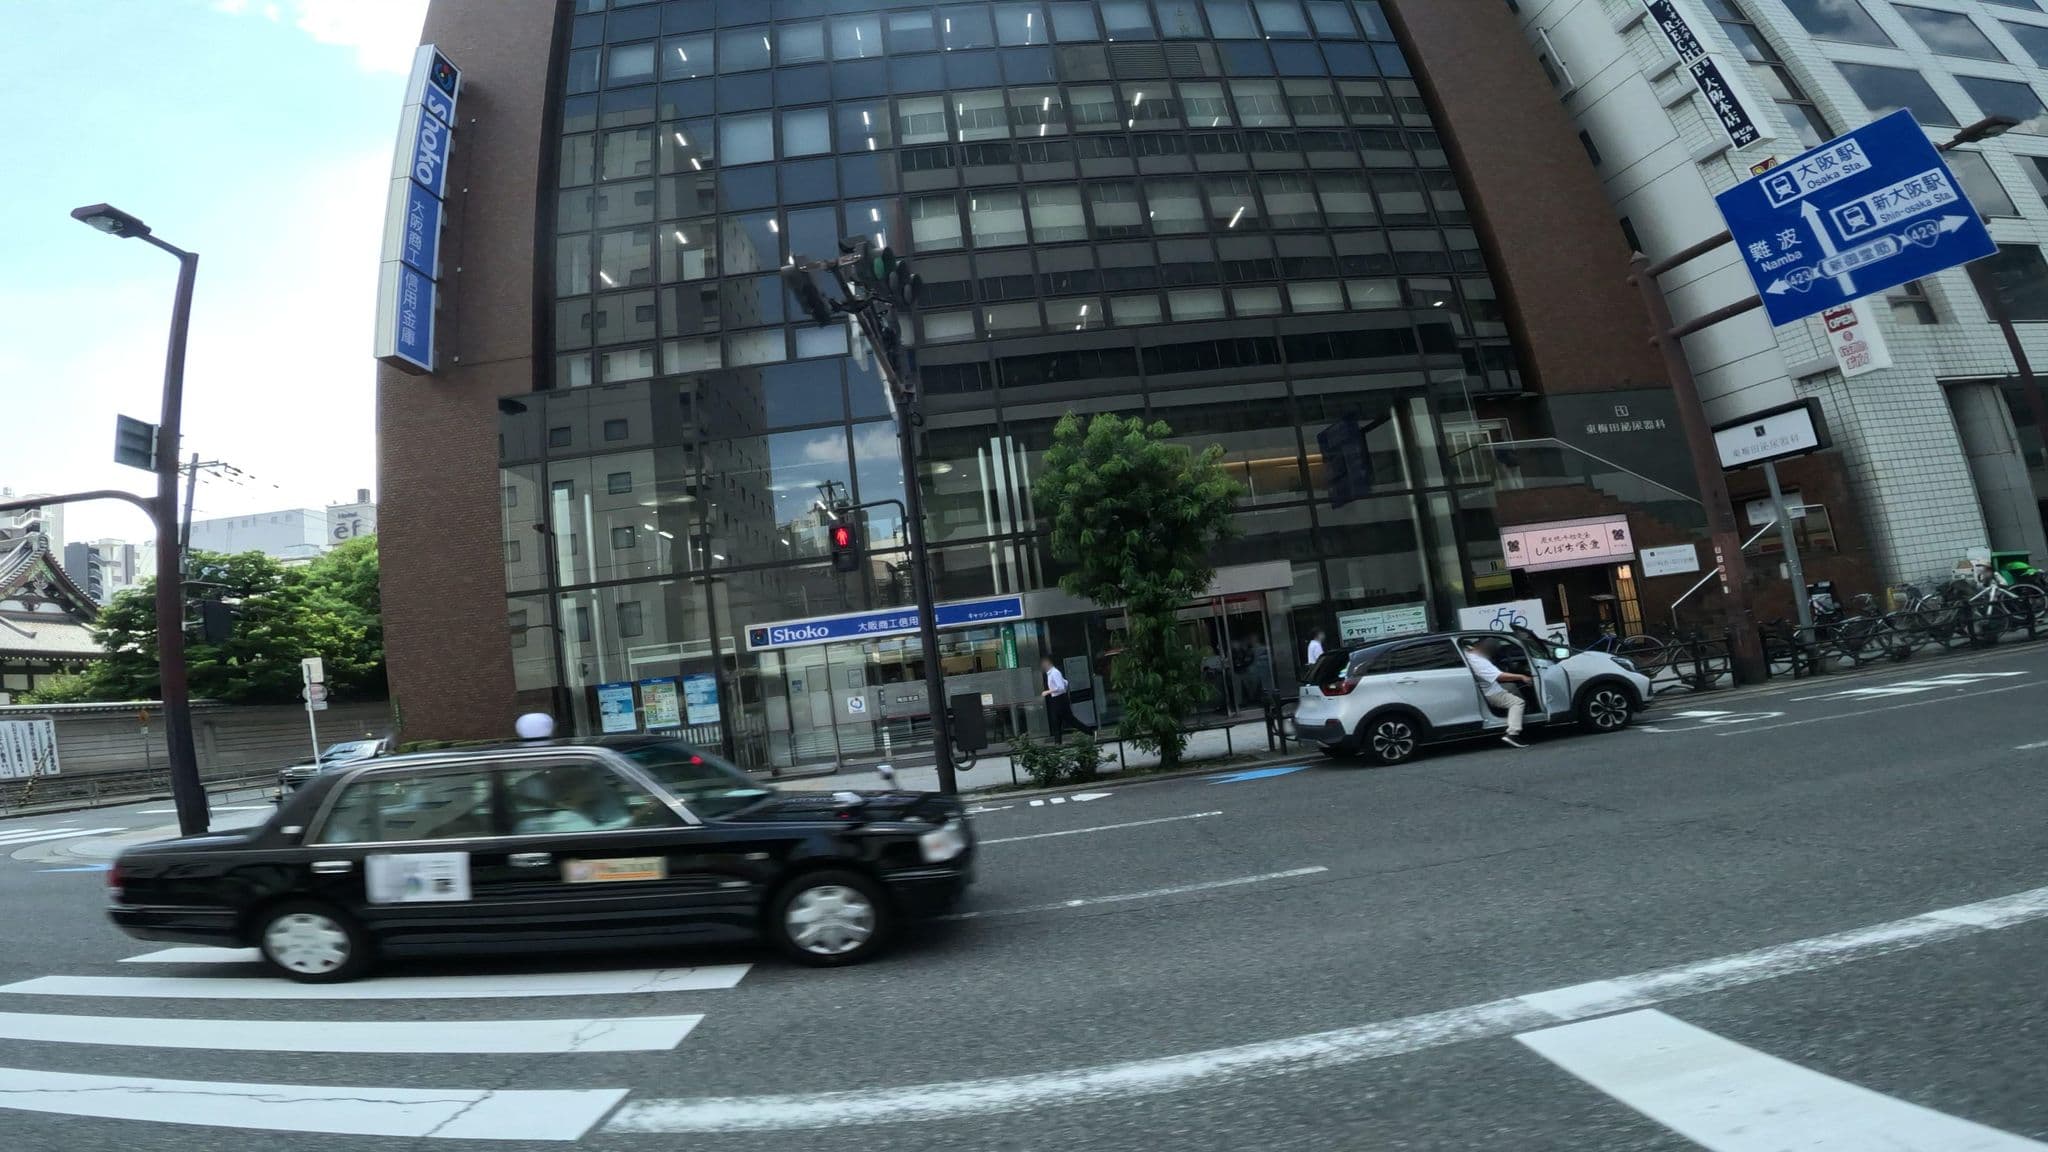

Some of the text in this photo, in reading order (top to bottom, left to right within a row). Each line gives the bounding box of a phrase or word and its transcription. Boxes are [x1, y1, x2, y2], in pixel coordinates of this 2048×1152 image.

[1703, 77, 1741, 128] 大阪本店
[415, 94, 447, 185] Shoko
[1797, 142, 1858, 181] 大阪駅
[1807, 160, 1864, 190] Osaka Sta.
[1871, 172, 1947, 211] 新大阪駅
[1879, 191, 1953, 224] Shin-osaka Sta.
[1748, 228, 1802, 262] 難波
[1911, 223, 1937, 241] 423
[401, 199, 425, 346] 大阪商工信用金庫
[1761, 250, 1803, 273] Namba
[1789, 270, 1812, 286] 423
[1586, 419, 1666, 434] 東梅田泌尿器科
[774, 625, 829, 643] Shoko
